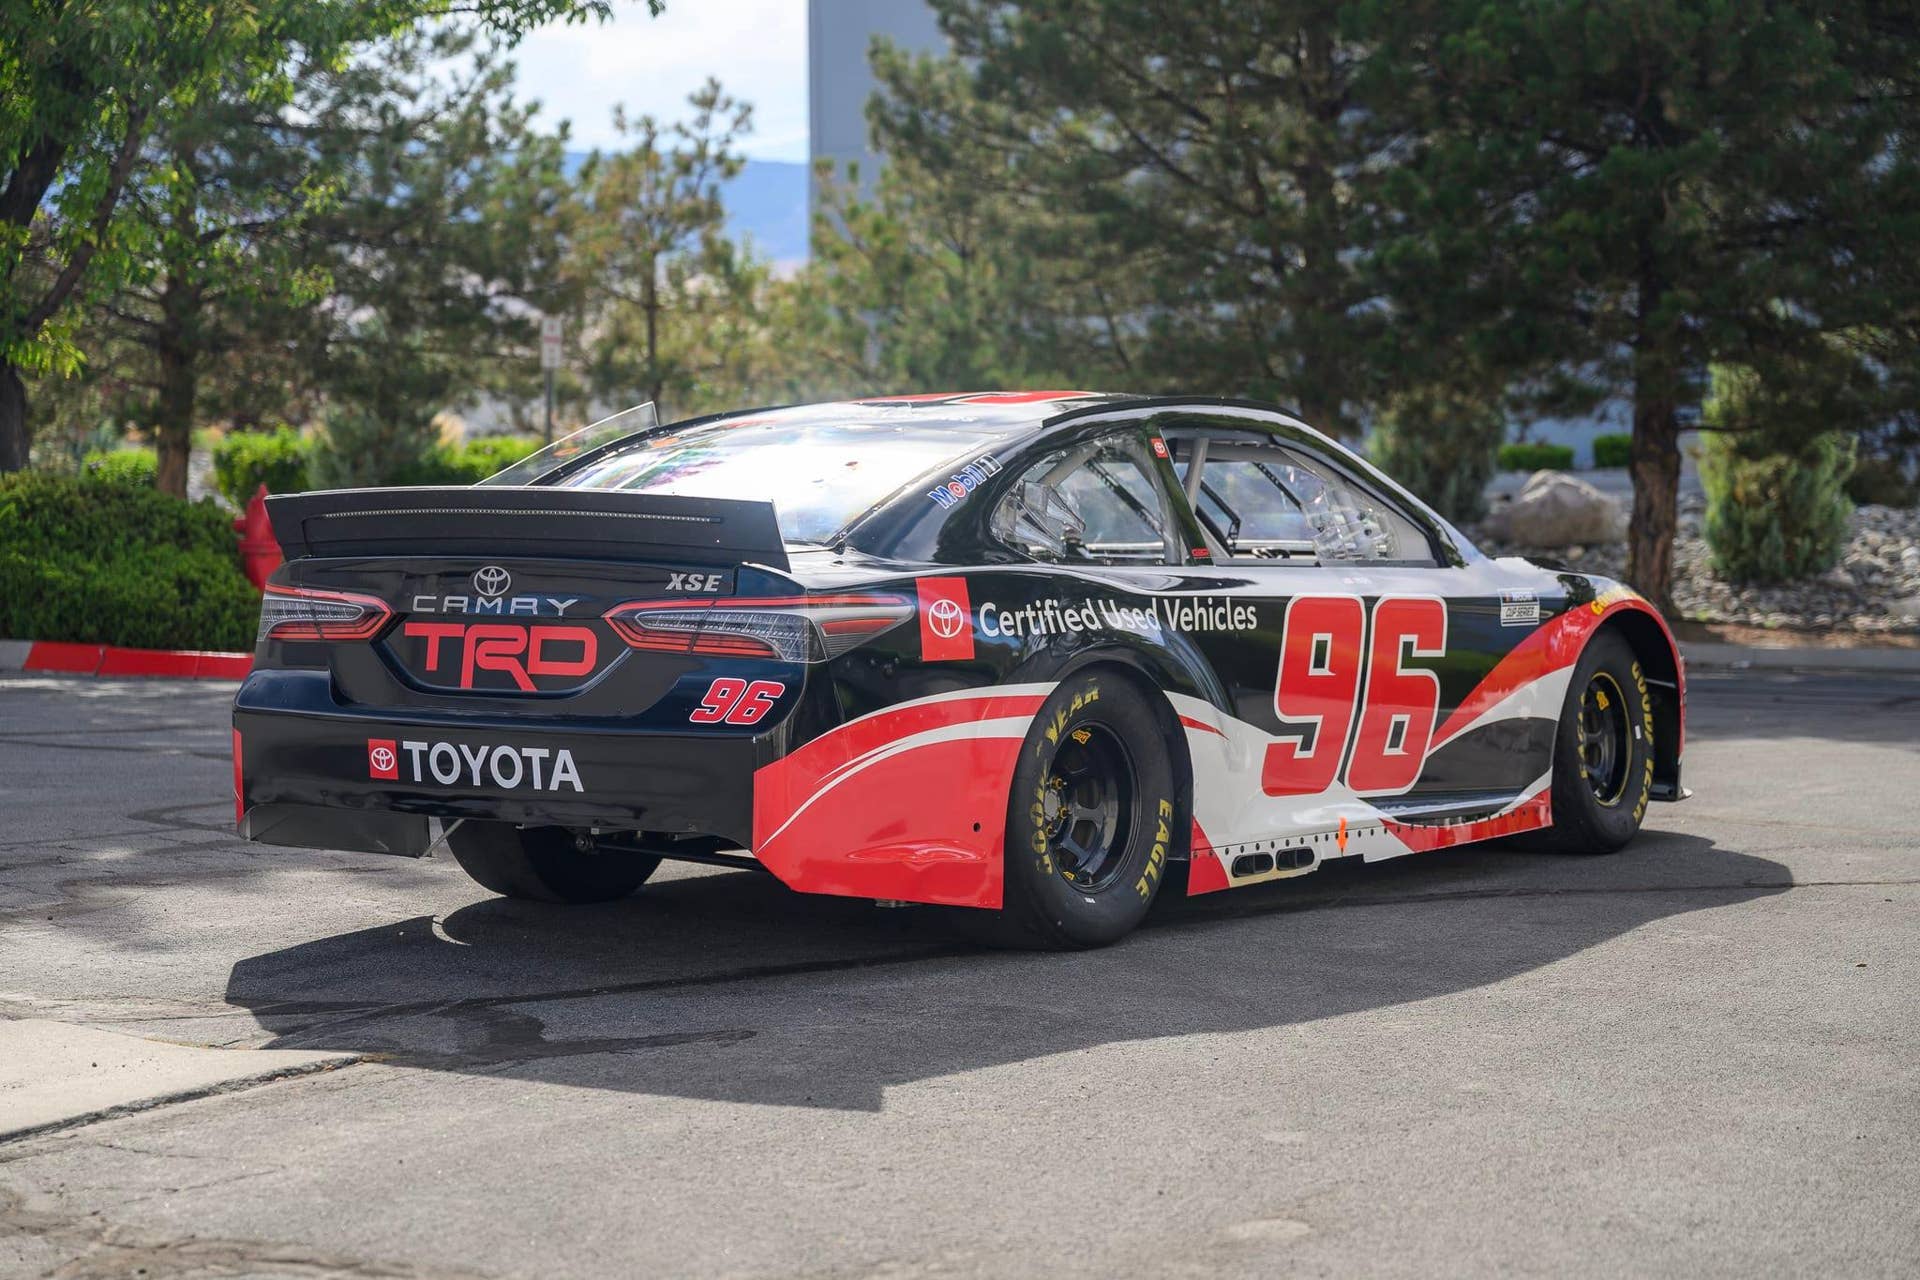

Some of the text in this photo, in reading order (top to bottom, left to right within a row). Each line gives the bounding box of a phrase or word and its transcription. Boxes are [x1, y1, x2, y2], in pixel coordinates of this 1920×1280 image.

[927, 464, 987, 509] Mobil
[412, 595, 579, 617] CAMRY
[665, 573, 722, 592] XSE
[979, 597, 1257, 637] Certified Used Vehicles
[404, 622, 598, 692] TRD
[689, 677, 786, 725] 96
[1261, 592, 1449, 798] 96
[402, 740, 584, 793] TOYOTA
[1135, 798, 1174, 903] EAGLE
